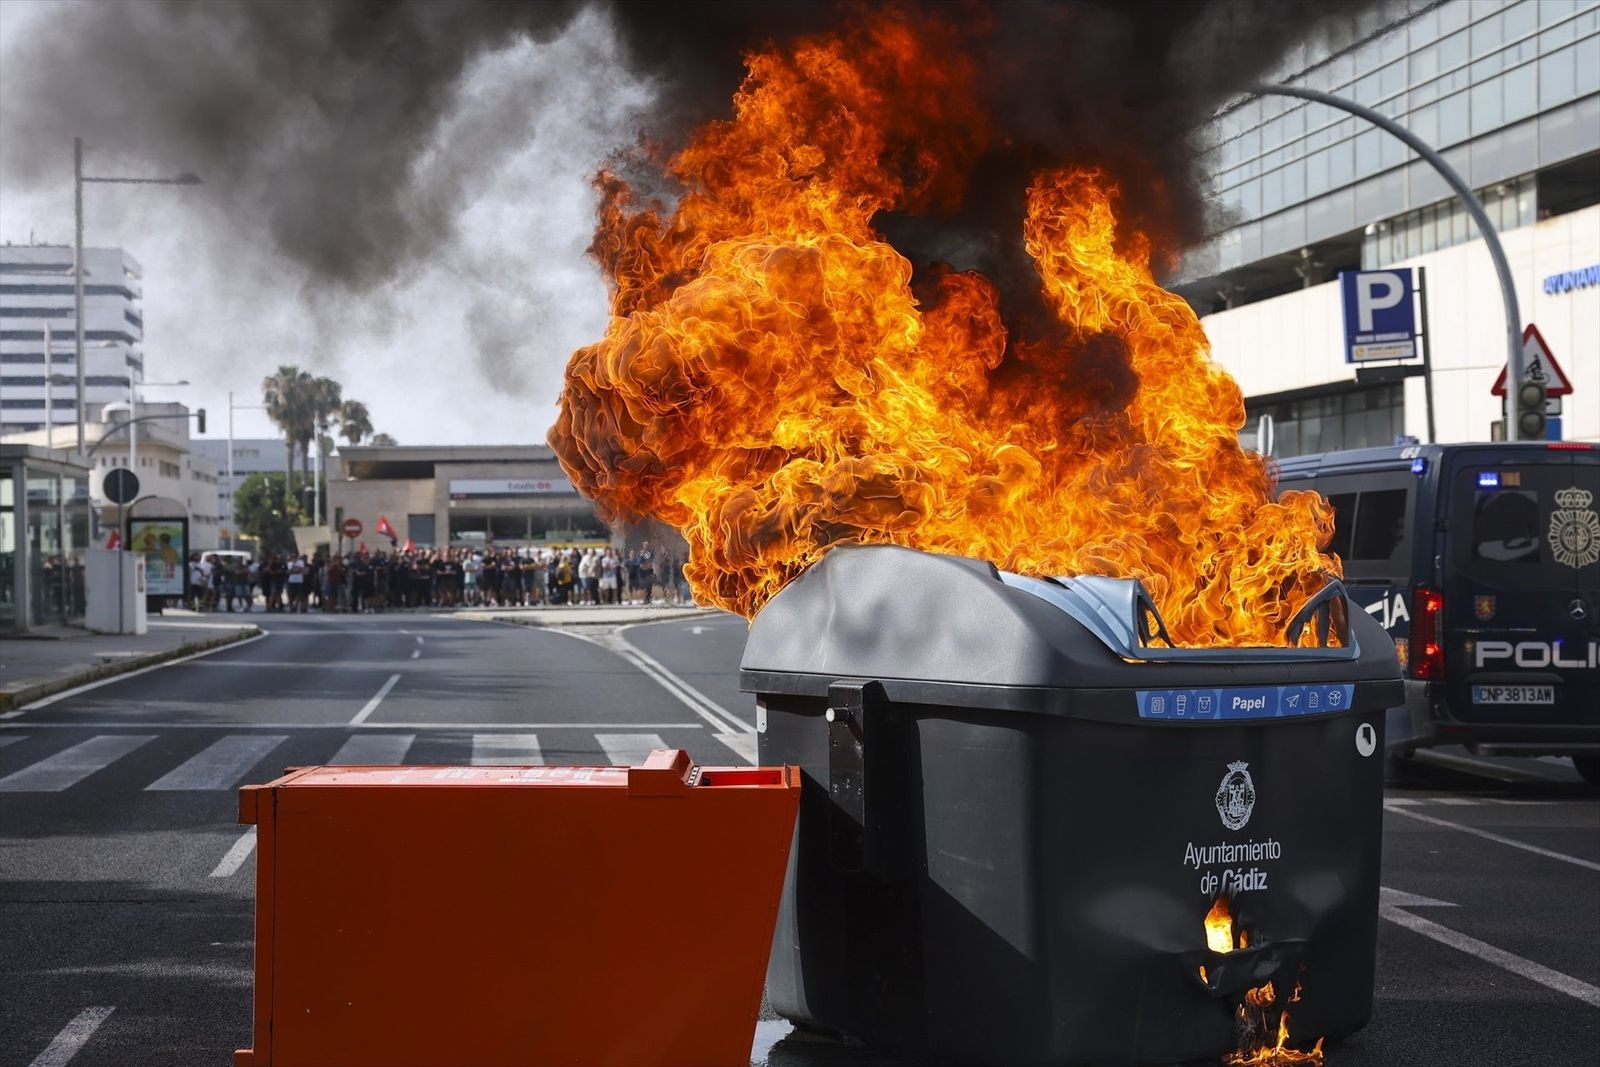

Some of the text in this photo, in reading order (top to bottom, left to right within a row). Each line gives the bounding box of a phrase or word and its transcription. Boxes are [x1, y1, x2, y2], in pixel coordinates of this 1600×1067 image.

[1356, 272, 1404, 332] P
[1476, 641, 1600, 668] POLI
[1232, 695, 1266, 712] Papel
[1480, 687, 1552, 702] CNP3813AW
[1184, 837, 1281, 870] Ayuntamiento
[1201, 867, 1267, 895] de Cádiz
